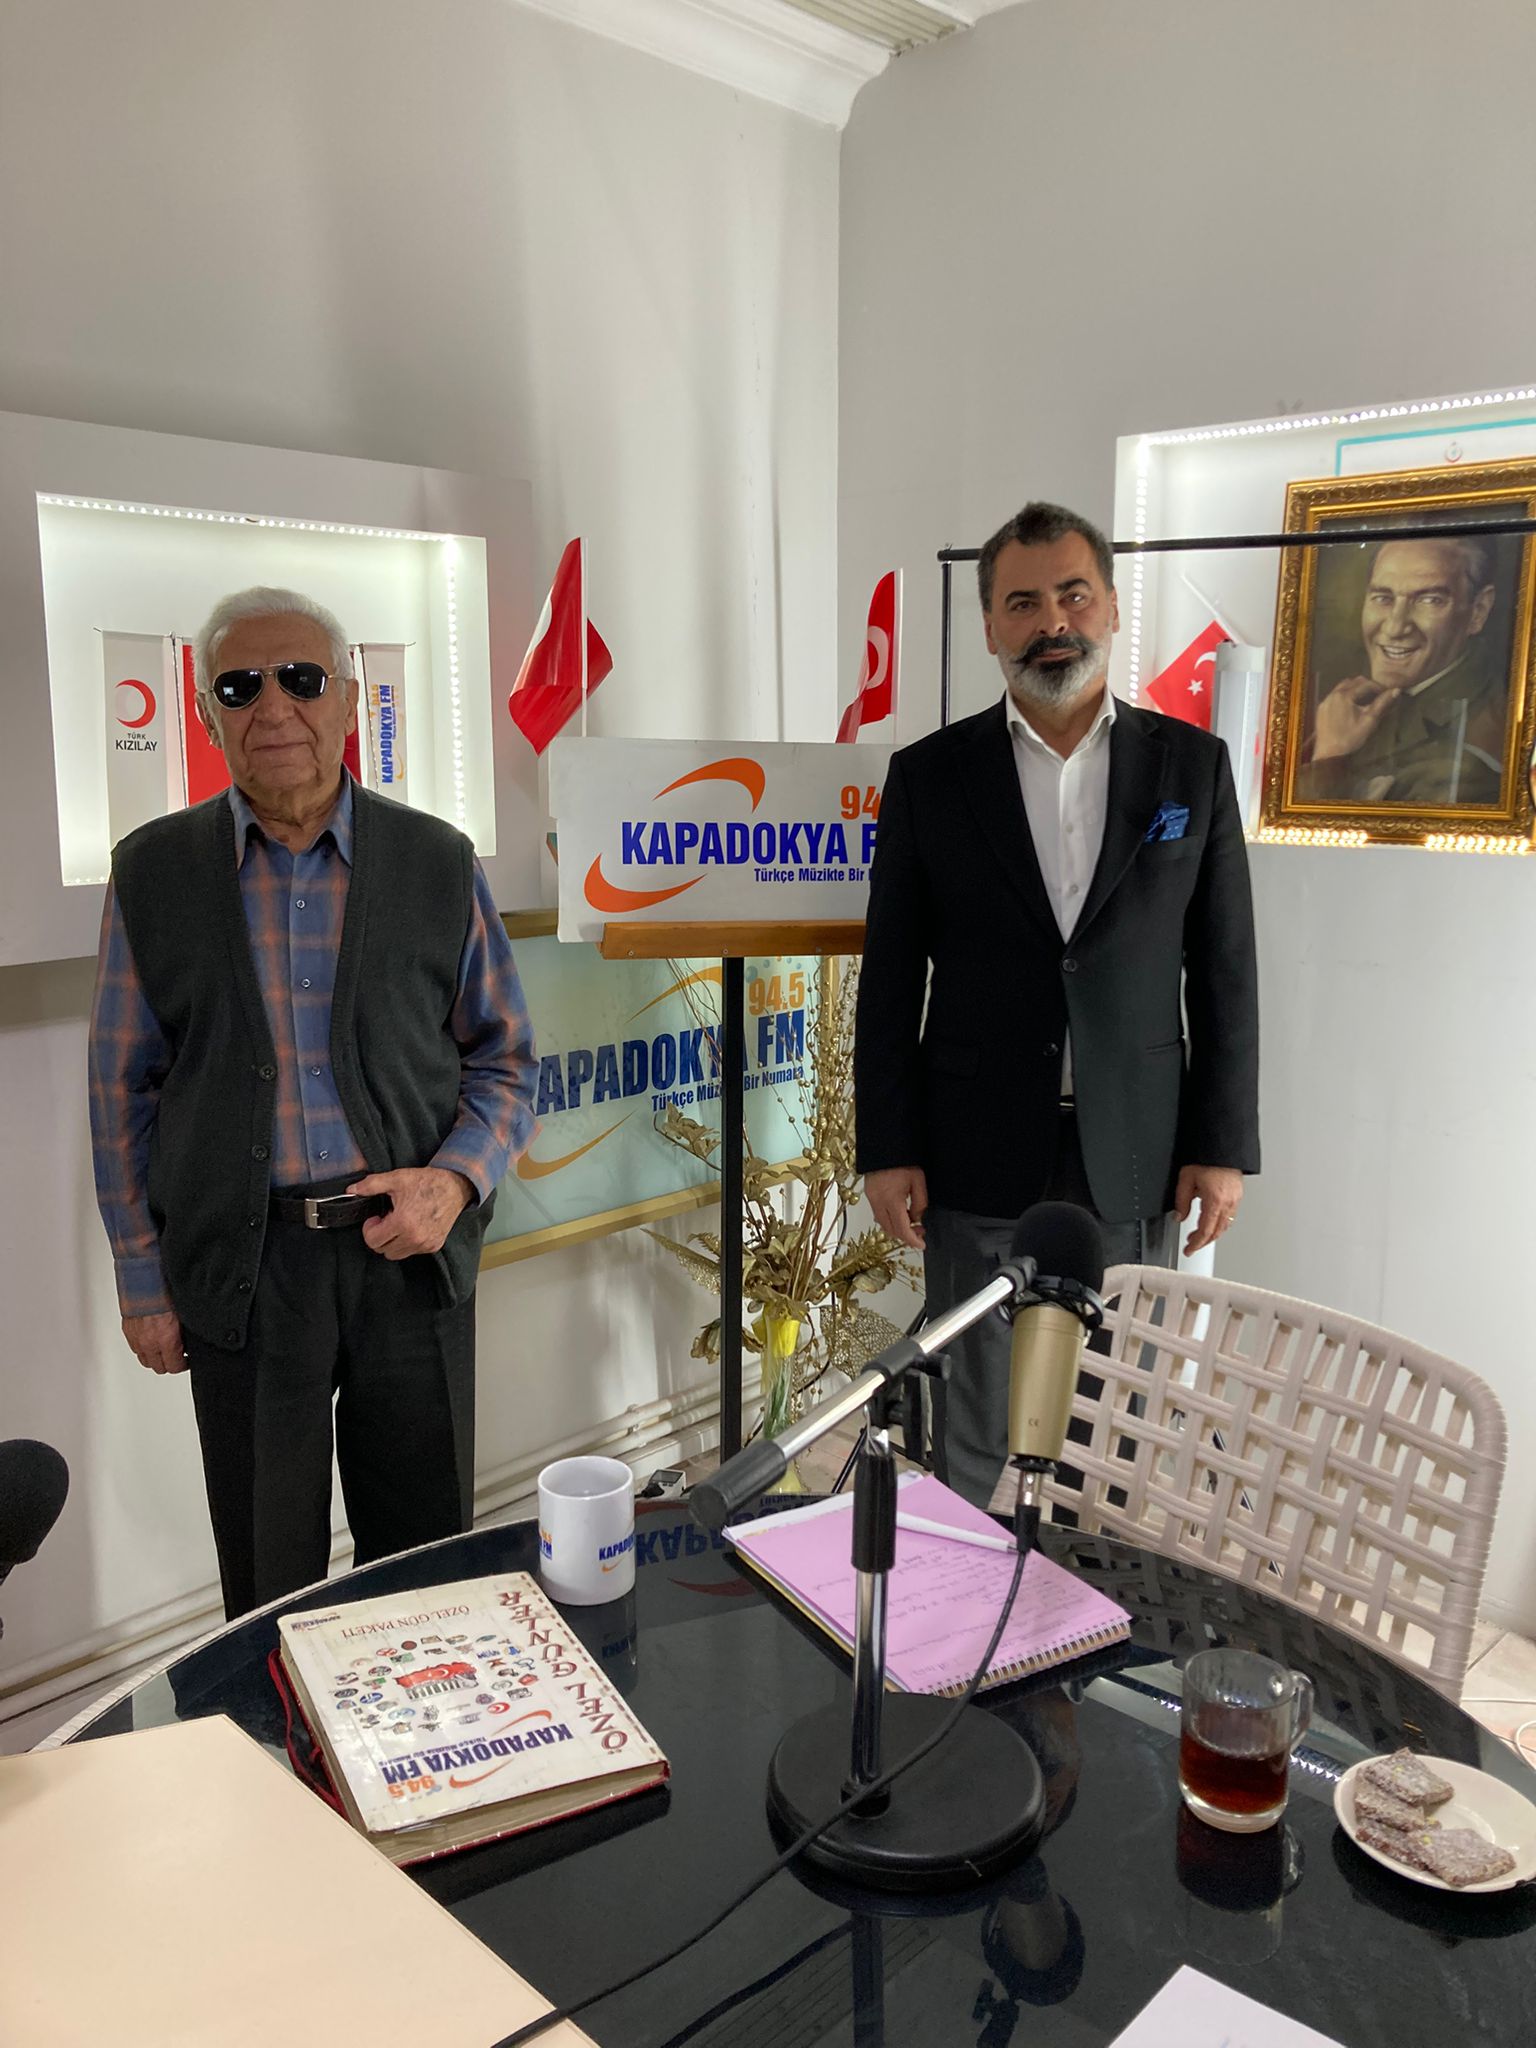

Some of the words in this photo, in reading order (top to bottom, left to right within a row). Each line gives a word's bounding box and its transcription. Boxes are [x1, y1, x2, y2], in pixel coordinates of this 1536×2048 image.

[379, 684, 391, 703] FM
[115, 739, 158, 752] KIZILAY
[127, 731, 146, 740] TÜRK
[380, 706, 393, 784] KAPADOKYA
[621, 821, 848, 865] KAPADOKYA
[754, 867, 795, 884] Türkçe
[798, 867, 845, 882] Müzikte
[848, 868, 865, 882] Bir
[748, 971, 805, 1016] 94.5
[757, 1009, 805, 1068] FM
[743, 1074, 760, 1092] Bir
[399, 1613, 431, 1628] GÜN
[438, 1605, 471, 1620] ÖZEL
[498, 1591, 578, 1679] GÜNLER
[563, 1682, 628, 1755] ÖZEL
[423, 1723, 575, 1774] KAPADOKYA
[381, 1761, 423, 1785] FM
[387, 1775, 437, 1799] 94.5
